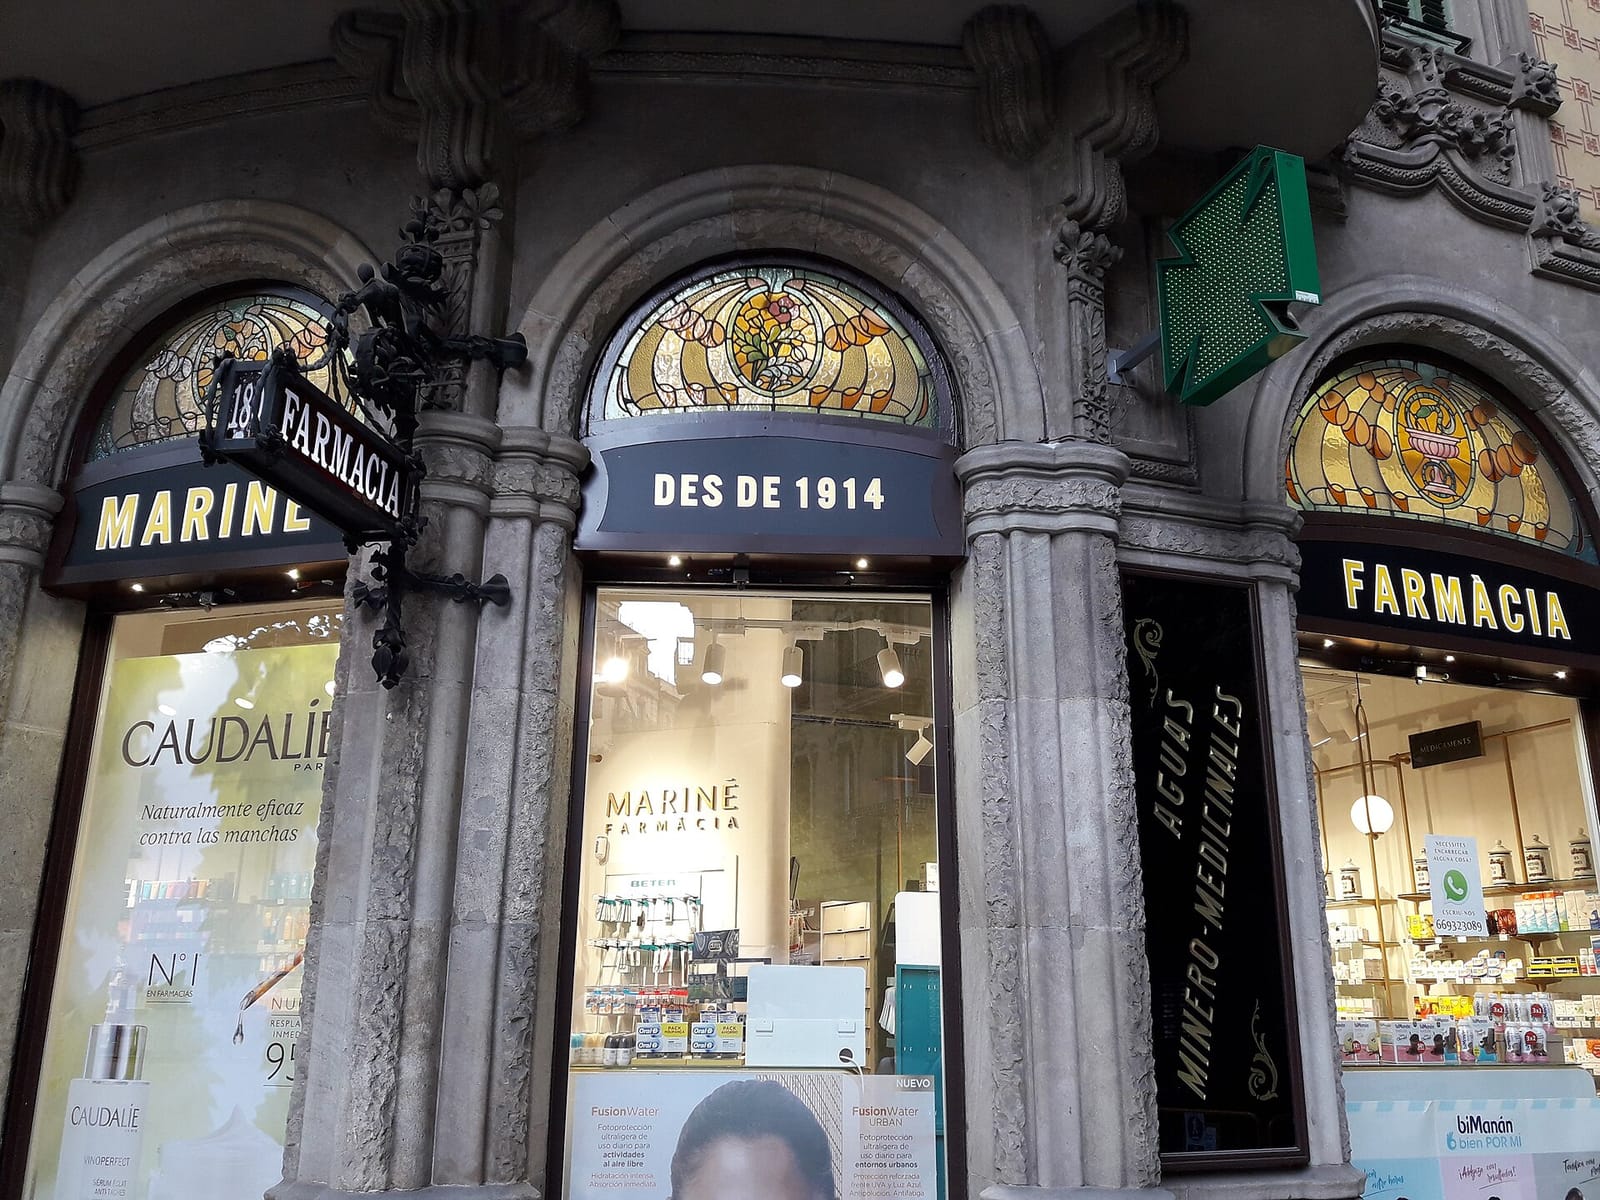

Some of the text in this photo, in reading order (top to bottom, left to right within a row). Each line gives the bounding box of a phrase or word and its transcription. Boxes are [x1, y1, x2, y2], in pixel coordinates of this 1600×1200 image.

[280, 387, 400, 518] FARMACIA
[653, 473, 885, 510] DES DE 1914
[1342, 557, 1572, 640] FARMÀCIA
[293, 763, 323, 772] PAR
[1153, 687, 1194, 840] AGUAS
[140, 799, 305, 822] Naturalmente eficaz
[139, 825, 299, 846] contra las manchas
[1435, 918, 1483, 933] 669323089
[270, 1019, 301, 1028] RESPLA
[272, 1030, 301, 1039] INMED
[896, 1079, 931, 1088] NUEVO
[591, 1106, 660, 1117] FusionWater
[852, 1106, 919, 1117] FusionWater
[869, 1118, 903, 1127] URBAN
[1457, 1115, 1514, 1134] biManán
[597, 1124, 652, 1132] Fotoprotección
[601, 1133, 637, 1142] ultraligera
[859, 1134, 914, 1143] Fotoprotección
[1459, 1137, 1483, 1149] bien
[1486, 1136, 1507, 1148] POR
[634, 1143, 651, 1151] para
[602, 1151, 645, 1159] actividades
[627, 1160, 644, 1168] libre
